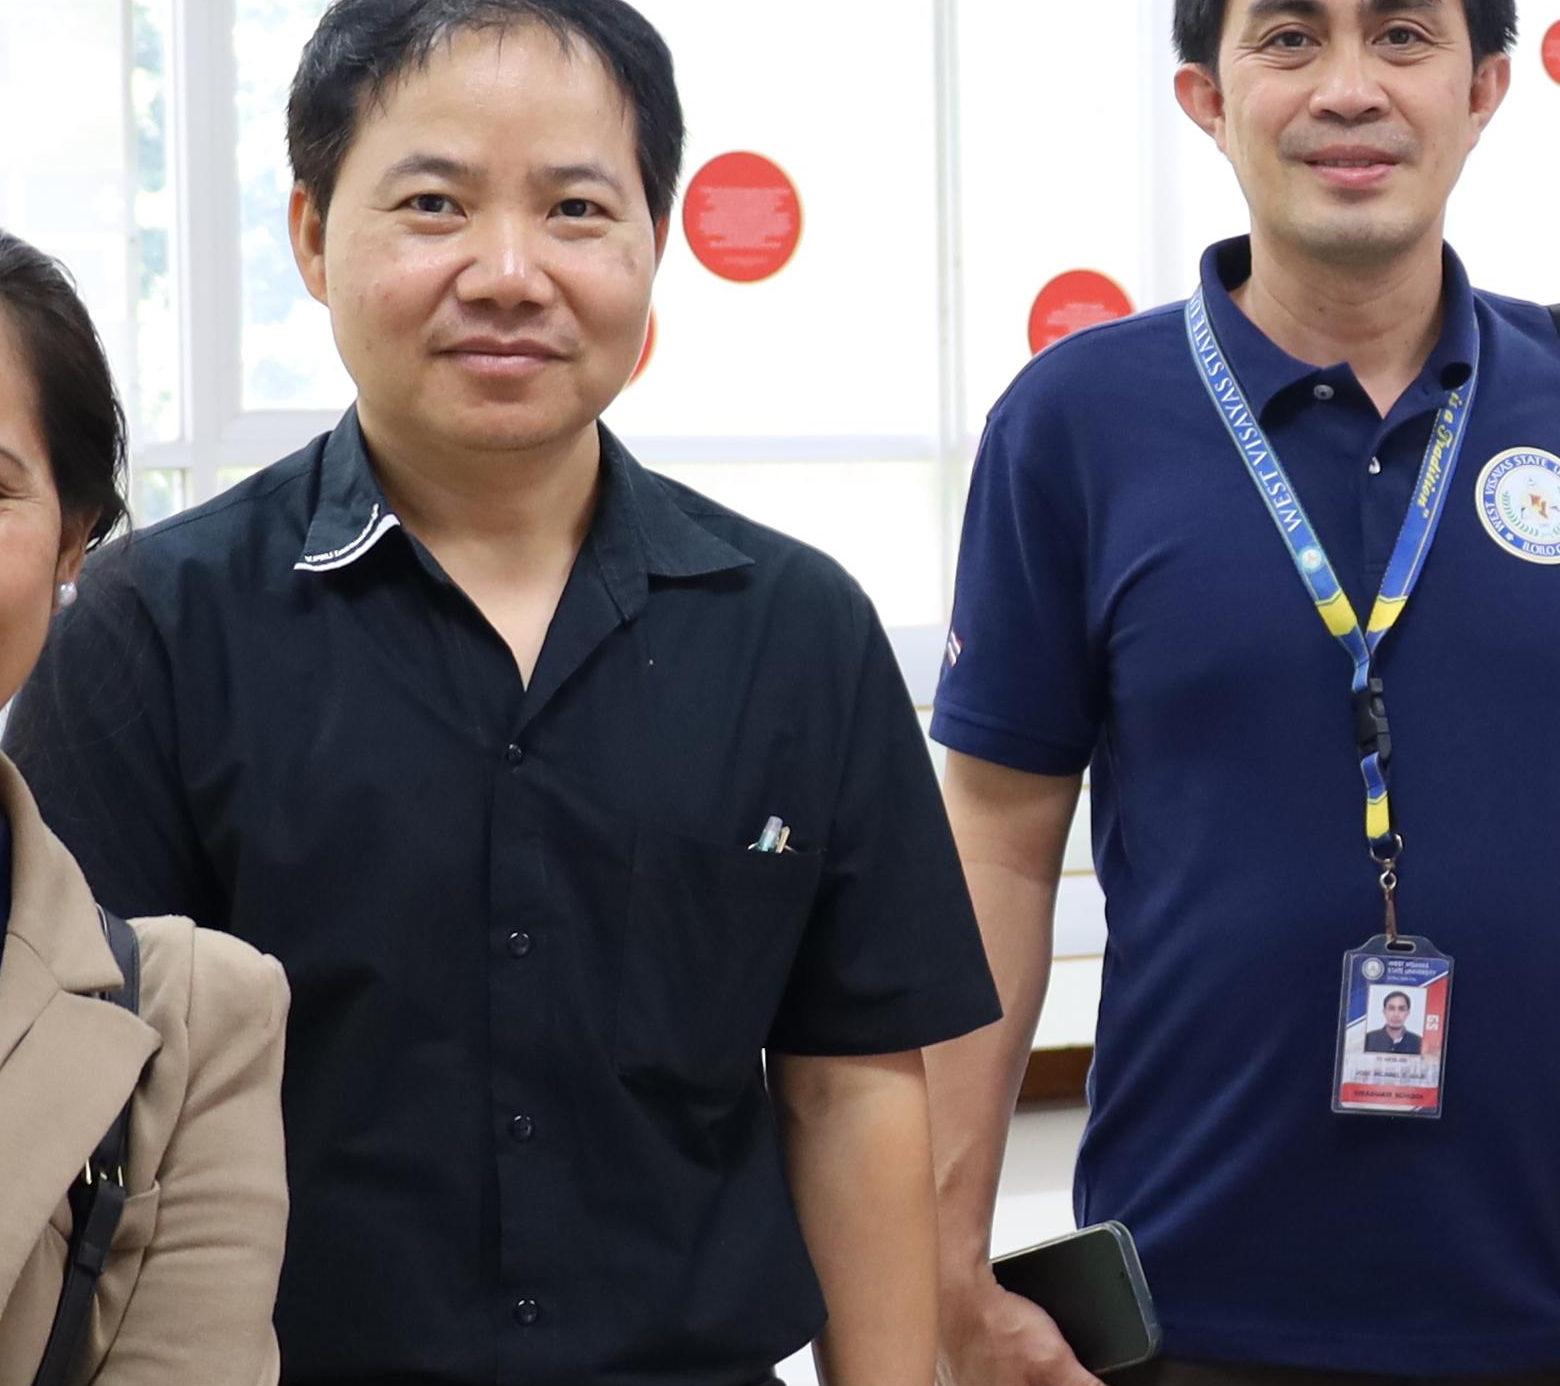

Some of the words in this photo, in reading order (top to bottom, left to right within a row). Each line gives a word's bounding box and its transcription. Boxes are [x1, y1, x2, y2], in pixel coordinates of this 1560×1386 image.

[1191, 315, 1225, 377] STATE
[1214, 378, 1268, 467] VISAYAS
[1484, 459, 1514, 495] VISAYAS
[1514, 454, 1547, 466] STATE
[1259, 469, 1302, 532] WEST
[1484, 502, 1505, 532] WEST
[1522, 541, 1555, 556] ILOILO
